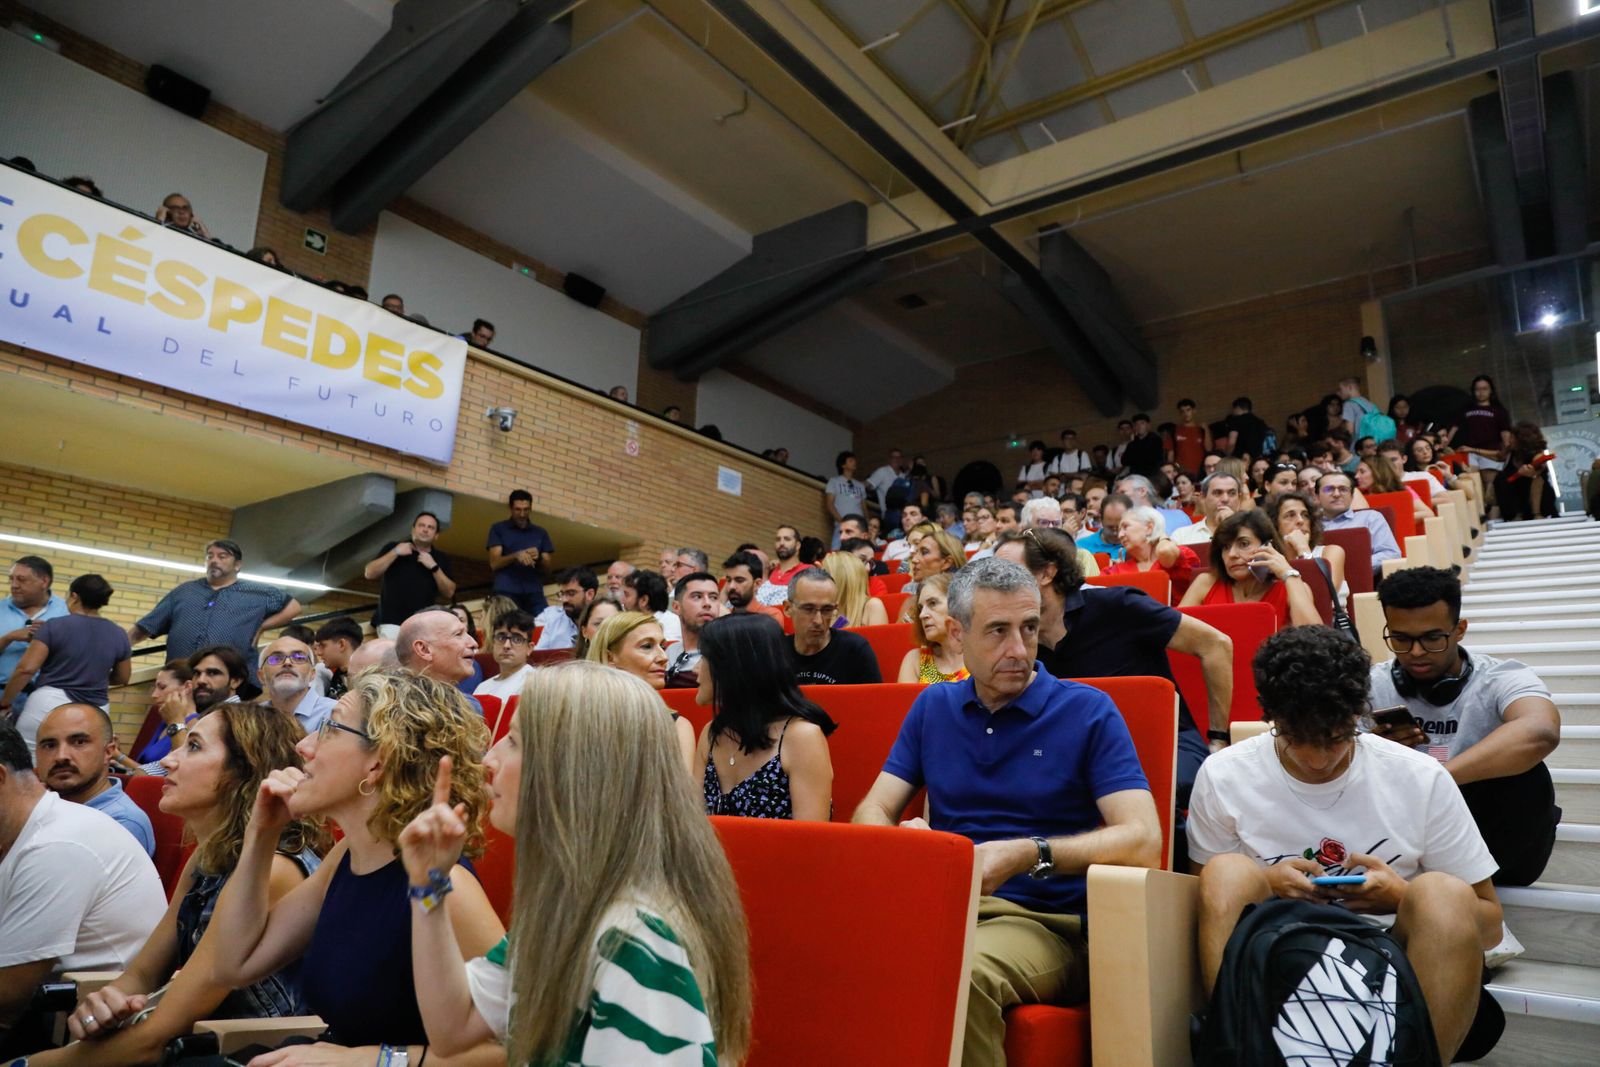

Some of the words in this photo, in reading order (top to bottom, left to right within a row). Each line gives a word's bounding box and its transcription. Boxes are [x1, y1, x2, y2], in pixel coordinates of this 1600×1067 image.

[17, 213, 446, 400] CÉSPEDES
[162, 336, 245, 376] DEL
[287, 376, 443, 433] FUTURO
[813, 671, 836, 684] SUPPLY
